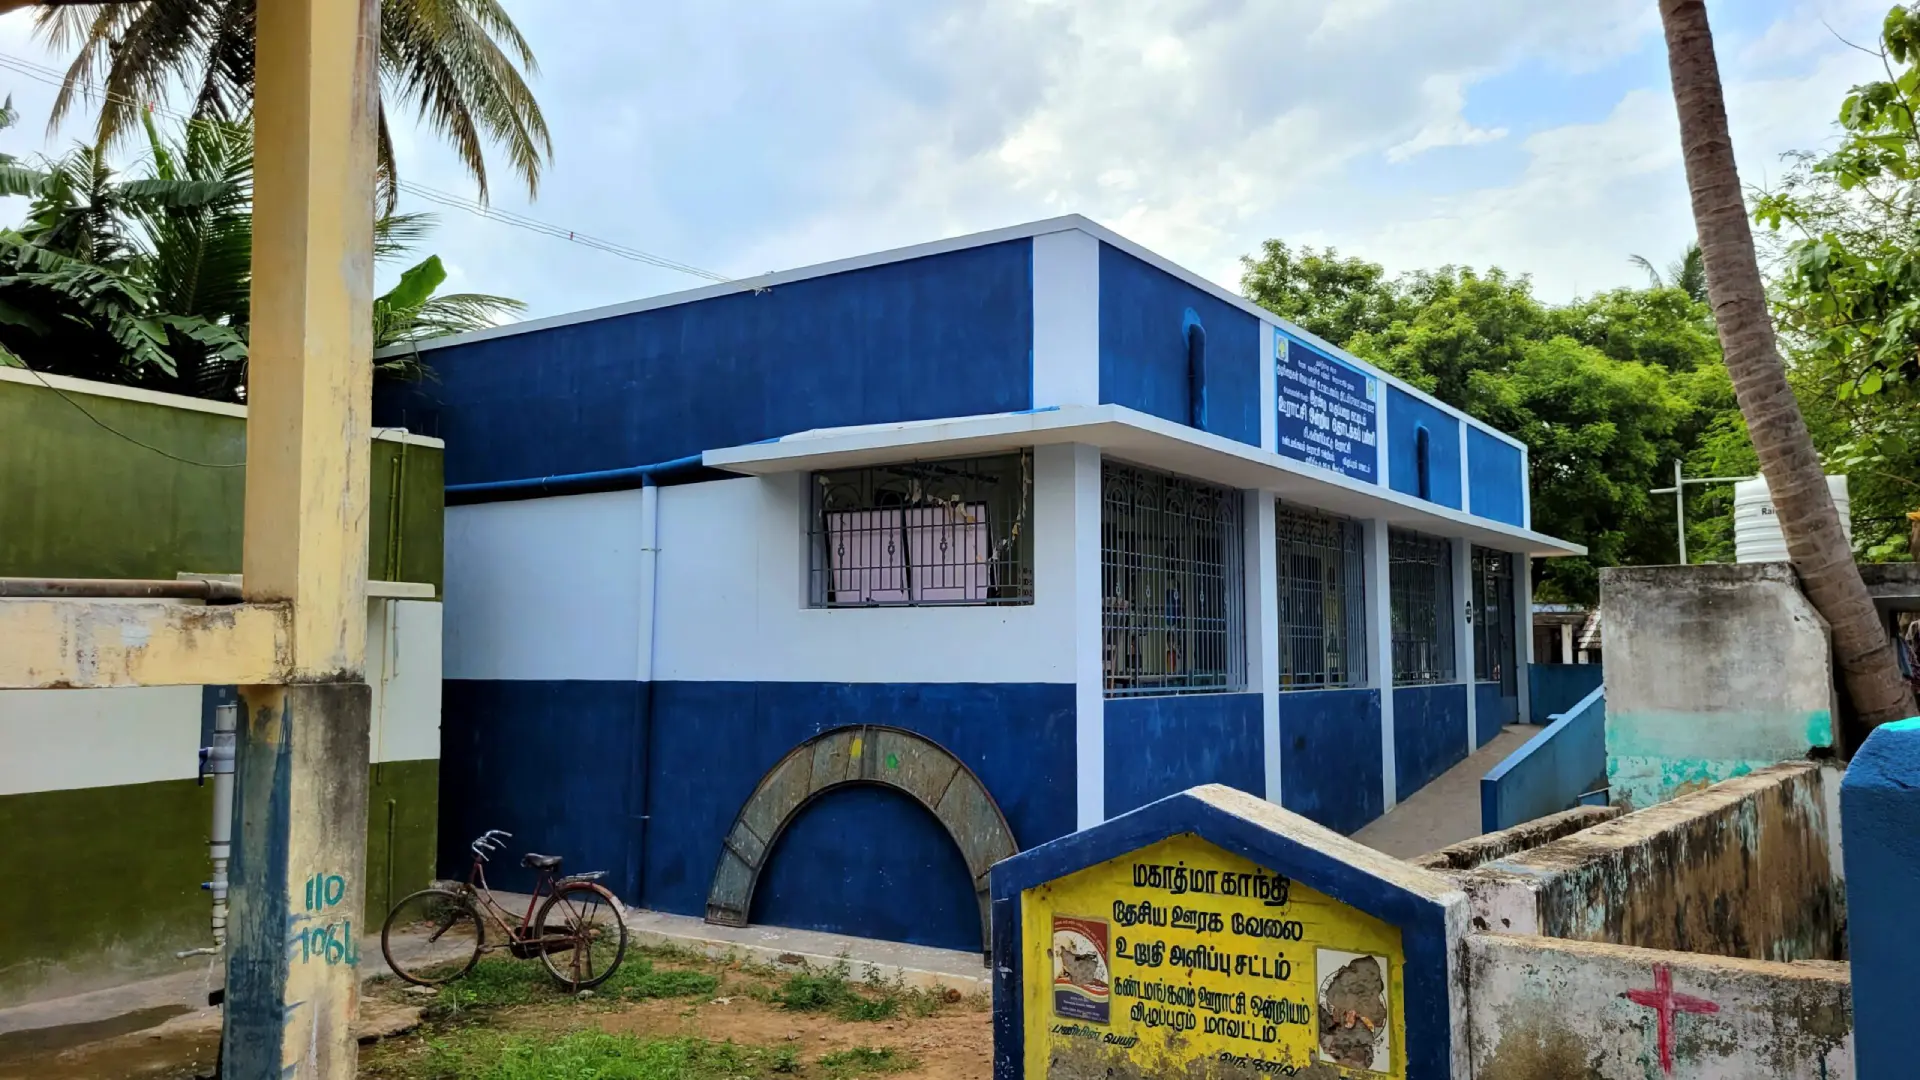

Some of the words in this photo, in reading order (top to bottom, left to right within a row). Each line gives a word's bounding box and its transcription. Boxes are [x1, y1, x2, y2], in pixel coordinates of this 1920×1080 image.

[1278, 395, 1308, 421] ஊராட்சி
[1761, 507, 1775, 515] Rai
[305, 872, 346, 911] 110
[1133, 861, 1218, 894] மகாத்மா
[1220, 867, 1291, 907] காந்தி
[1113, 900, 1167, 927] தேசிய
[1171, 905, 1224, 934] ஊரக
[1231, 912, 1303, 941] வேலை
[1115, 936, 1166, 967] உறுதி
[1169, 944, 1230, 977] அளிப்பு
[1234, 951, 1292, 981] சட்டம்
[1114, 974, 1196, 1008] கண்டமங்கலம்
[1198, 986, 1247, 1015] ஊராட்சி
[1250, 994, 1311, 1025] ஒன்றியம்
[1130, 1001, 1196, 1032] விழுப்புரம்
